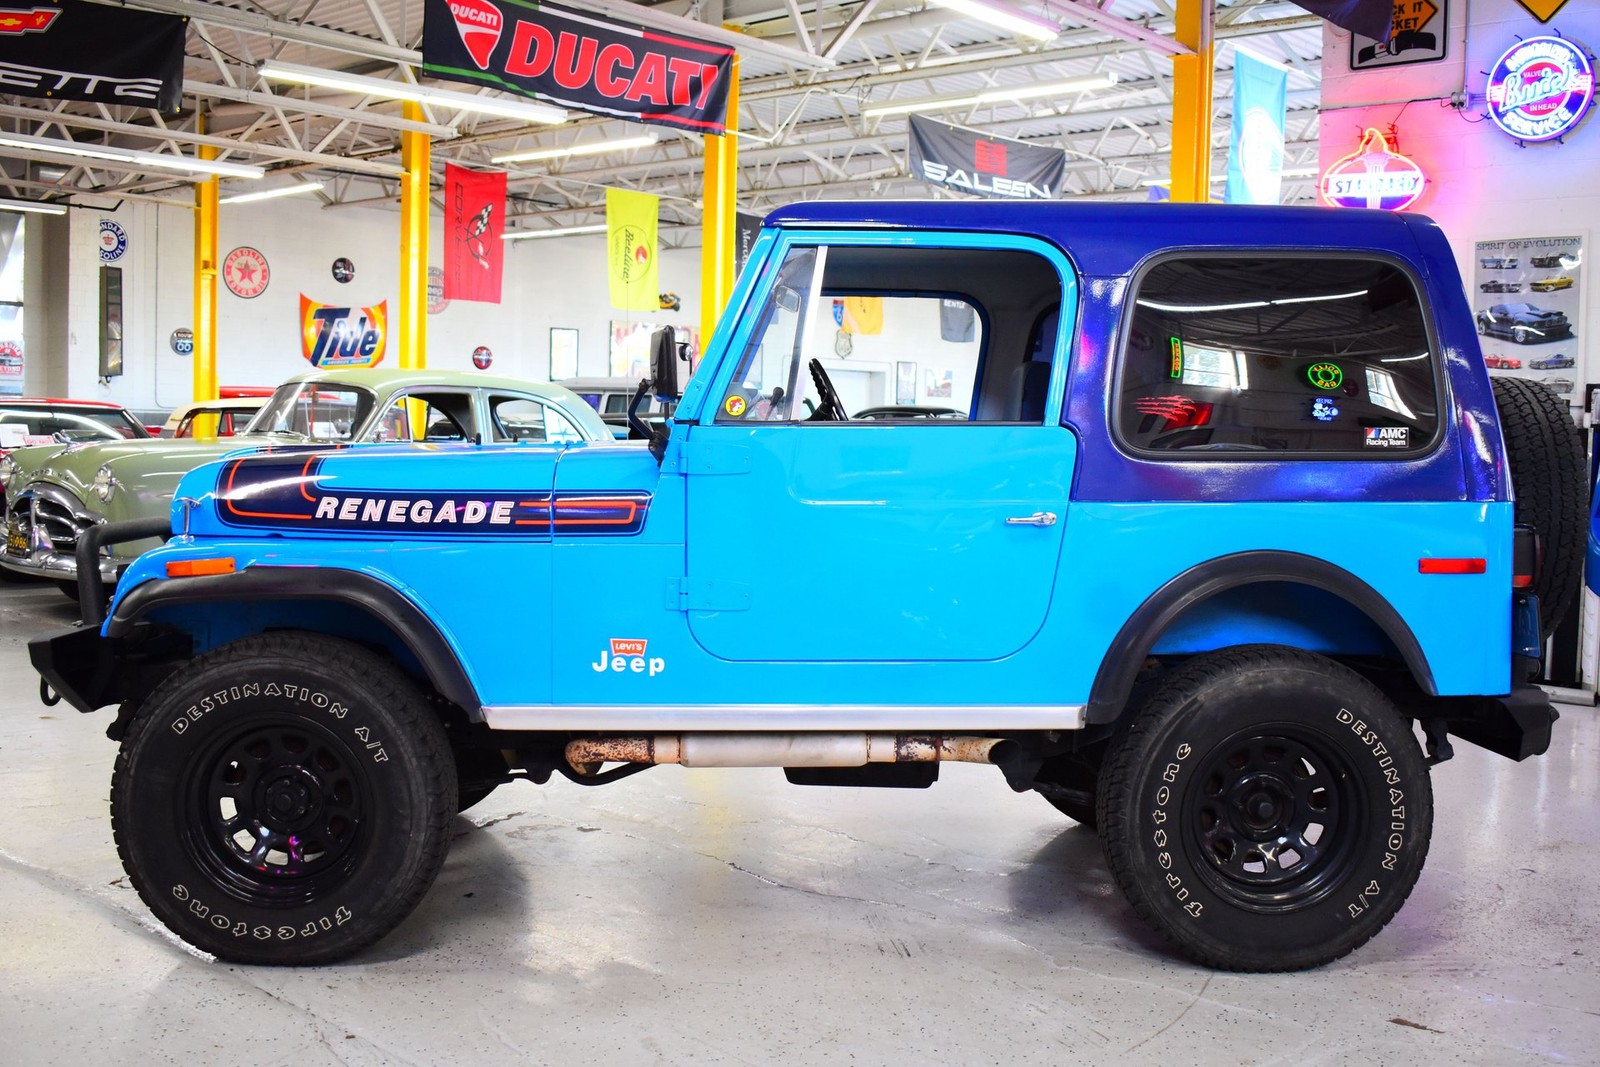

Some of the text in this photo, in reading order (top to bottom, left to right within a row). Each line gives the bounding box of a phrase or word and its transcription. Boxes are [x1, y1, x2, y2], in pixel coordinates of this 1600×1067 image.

[451, 4, 498, 27] DUCATI
[1413, 2, 1424, 13] IT
[504, 20, 720, 110] DUCATI
[0, 62, 163, 99] ETTE
[1503, 107, 1573, 134] SERVICE
[1538, 103, 1557, 111] HEAD
[922, 160, 1052, 199] SALEEN
[100, 222, 125, 241] NDARD
[1509, 241, 1521, 249] OF
[1523, 238, 1580, 249] EVOLUTION
[100, 244, 125, 260] SOLINE
[623, 229, 635, 280] Beeline
[177, 341, 192, 352] 66
[310, 308, 380, 368] Tide
[1366, 438, 1406, 447] Racing Team
[1379, 428, 1406, 439] AMC
[315, 496, 515, 525] RENEGADE
[592, 650, 665, 677] Jeep
[171, 682, 389, 764] DESTINATION A/T
[1336, 708, 1405, 918] DESTINATION A/T
[1152, 743, 1204, 918] Firestone
[172, 884, 353, 940] Firestone
